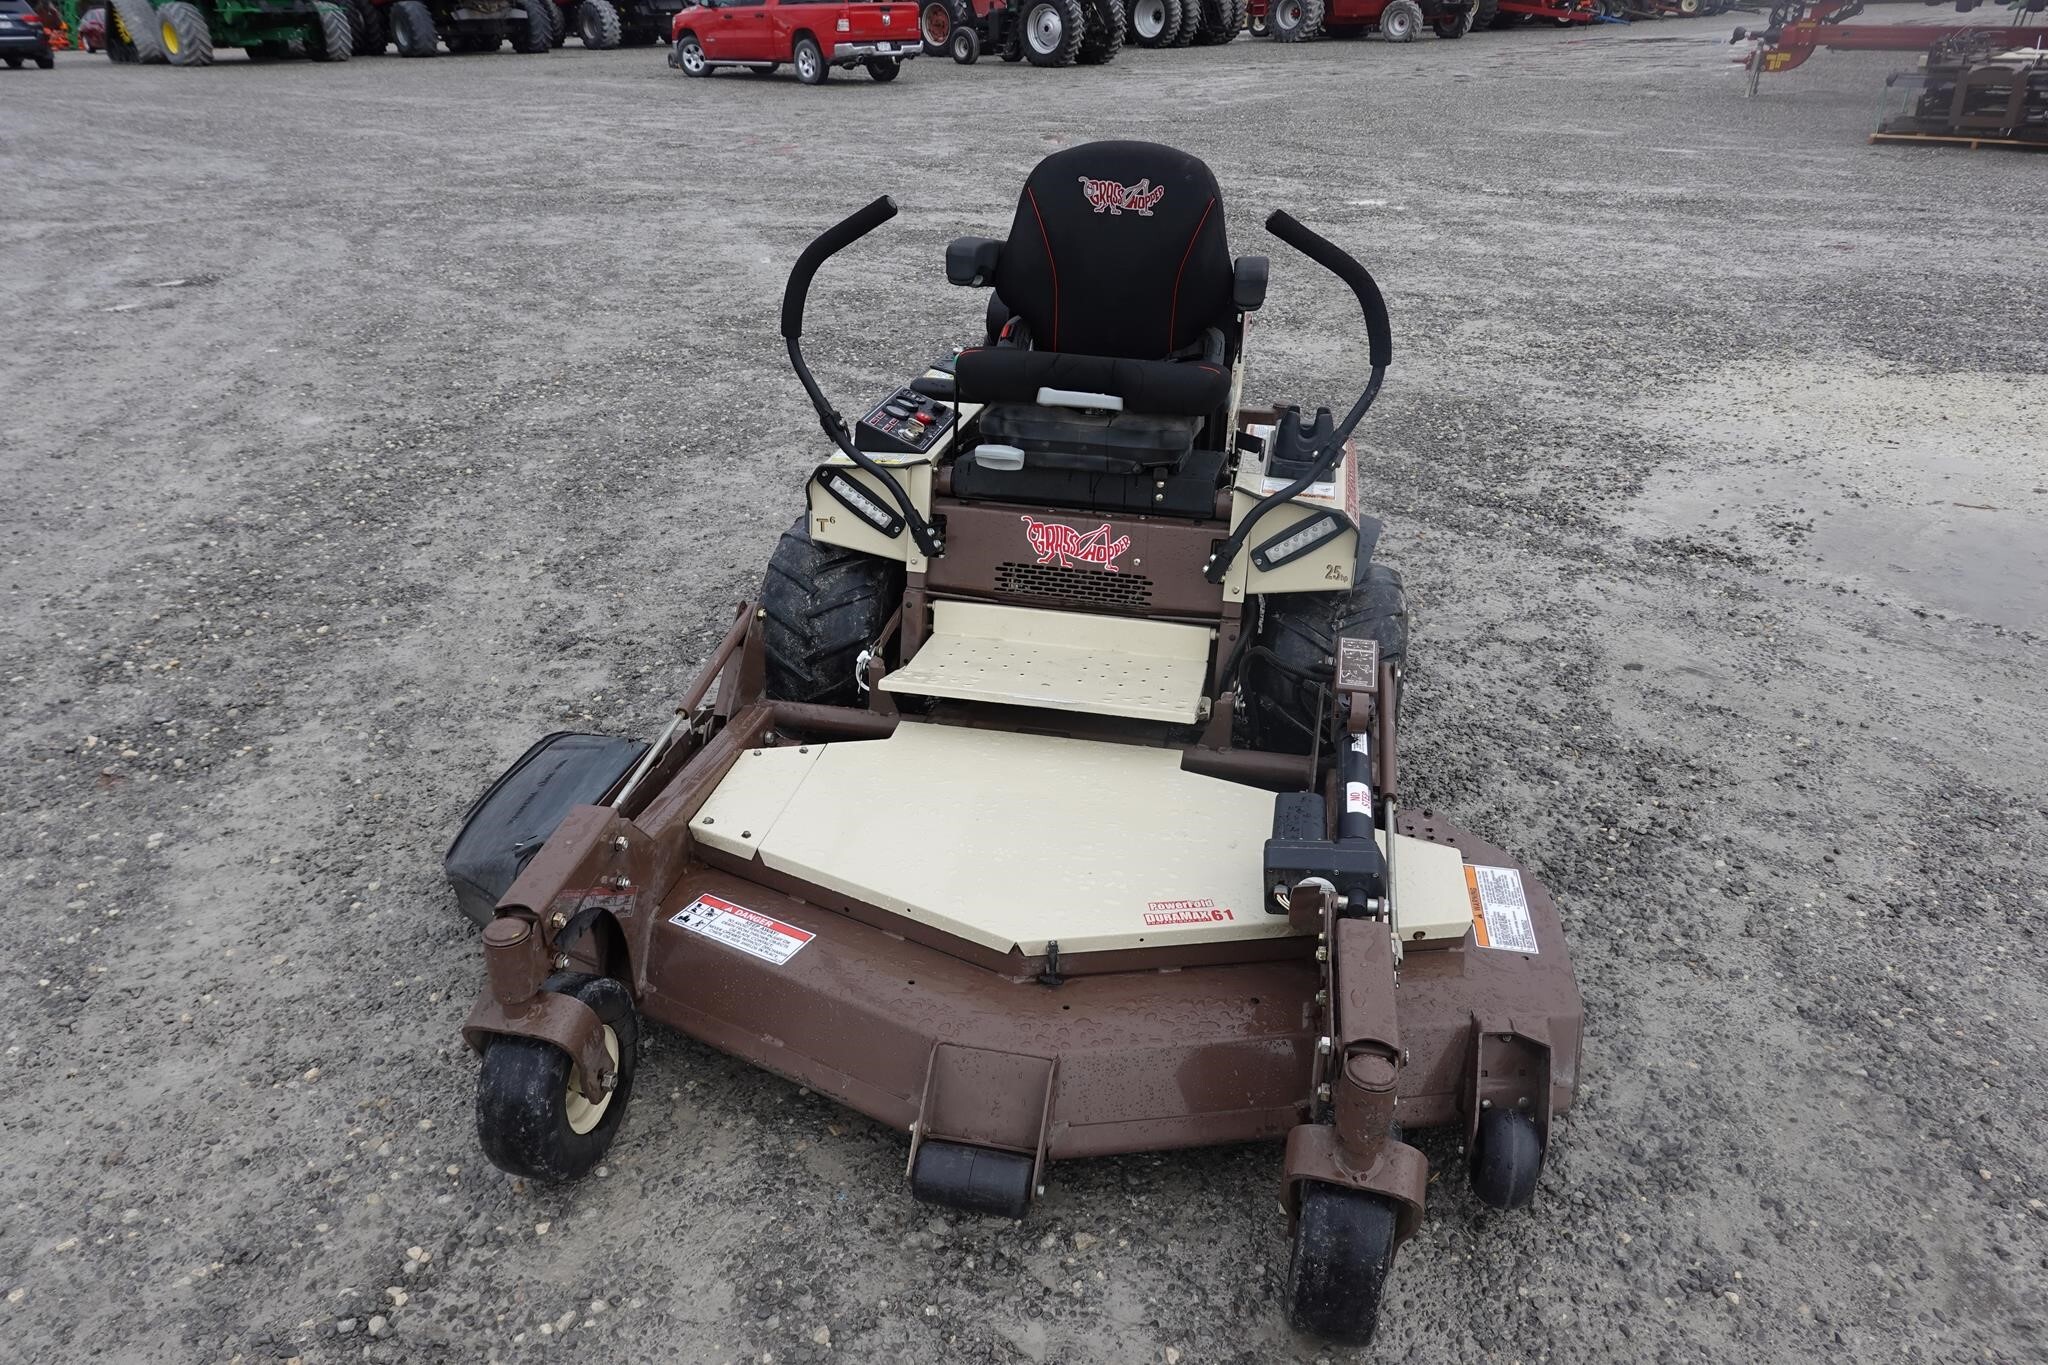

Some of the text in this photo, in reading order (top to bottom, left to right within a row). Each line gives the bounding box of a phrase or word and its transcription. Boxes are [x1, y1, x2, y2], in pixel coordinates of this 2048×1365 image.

[1350, 792, 1360, 801] NO
[1361, 790, 1370, 809] STEP
[1469, 886, 1481, 911] WARNING
[733, 908, 775, 927] DANGER
[1211, 909, 1234, 921] 61
[743, 920, 762, 929] KEEP
